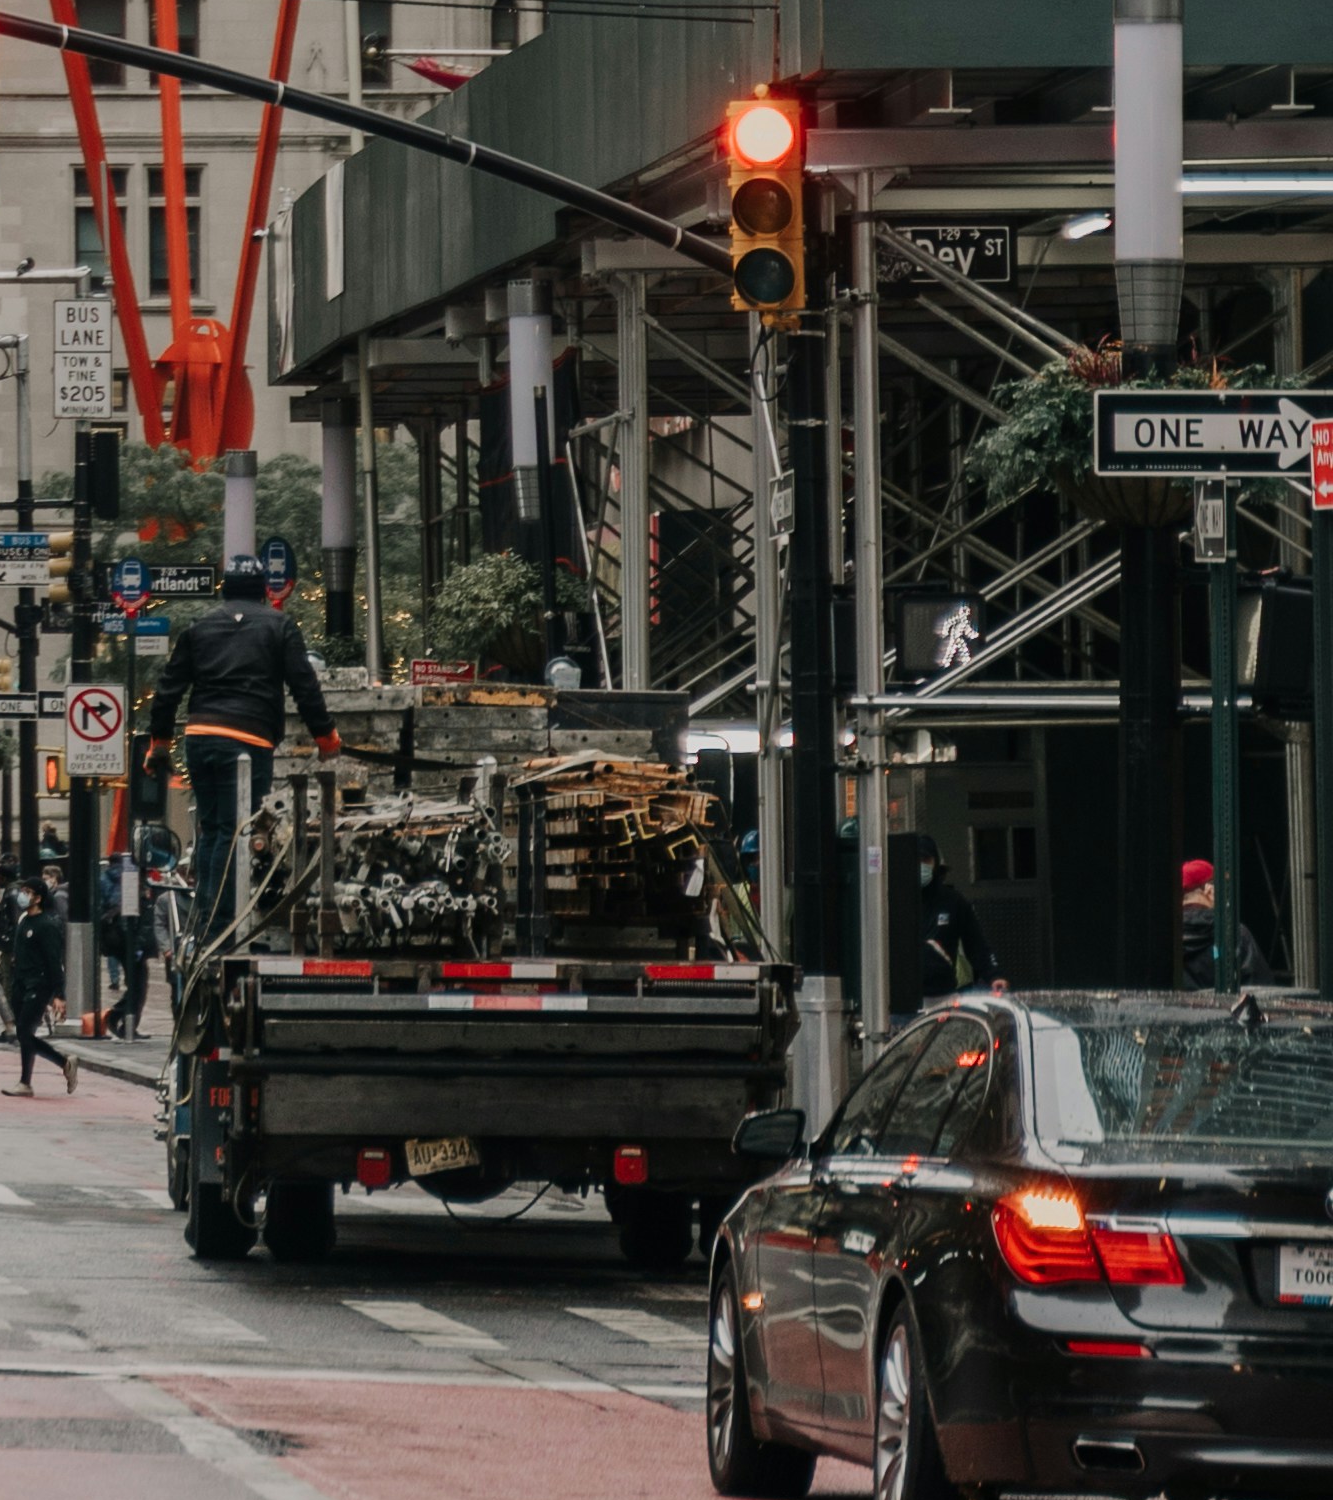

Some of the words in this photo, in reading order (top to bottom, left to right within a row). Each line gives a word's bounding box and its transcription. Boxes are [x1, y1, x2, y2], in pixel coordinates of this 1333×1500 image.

[938, 229, 960, 241] 1-29
[984, 238, 1004, 256] ST
[66, 306, 100, 323] BUS
[61, 330, 105, 346] LANE
[62, 356, 88, 368] TOW
[94, 356, 103, 368] &
[68, 370, 97, 382] FINE
[60, 385, 106, 402] $205
[62, 405, 104, 415] MINIMUM
[1134, 418, 1204, 448] ONE
[1239, 419, 1311, 449] WAY
[1315, 429, 1330, 446] NO
[11, 535, 31, 546] BUS
[200, 576, 211, 586] ST
[0, 702, 23, 712] ONE
[50, 700, 66, 711] ON
[86, 744, 104, 752] FOR
[75, 753, 117, 761] VEHICLES
[70, 762, 93, 771] OVER
[96, 762, 108, 771] 45
[110, 762, 122, 771] FT
